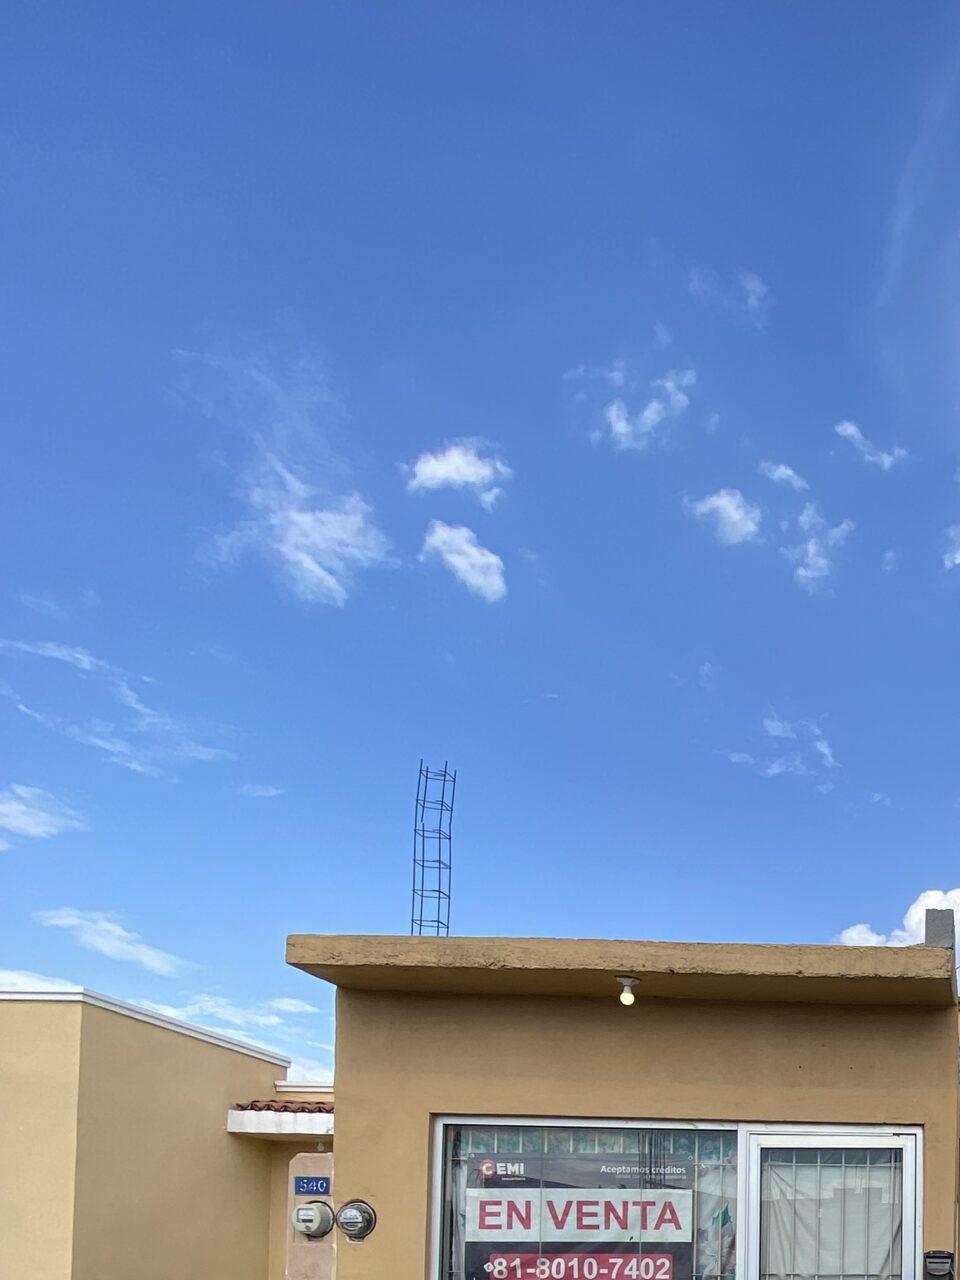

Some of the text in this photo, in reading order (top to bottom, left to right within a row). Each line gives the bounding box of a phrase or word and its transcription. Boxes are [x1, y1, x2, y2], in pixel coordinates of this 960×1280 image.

[482, 1162, 524, 1175] CEMI
[600, 1165, 649, 1174] Aceptamos
[299, 1180, 327, 1192] 540
[478, 1200, 682, 1230] EN VENTA
[492, 1257, 671, 1280] 81-8010-7402
